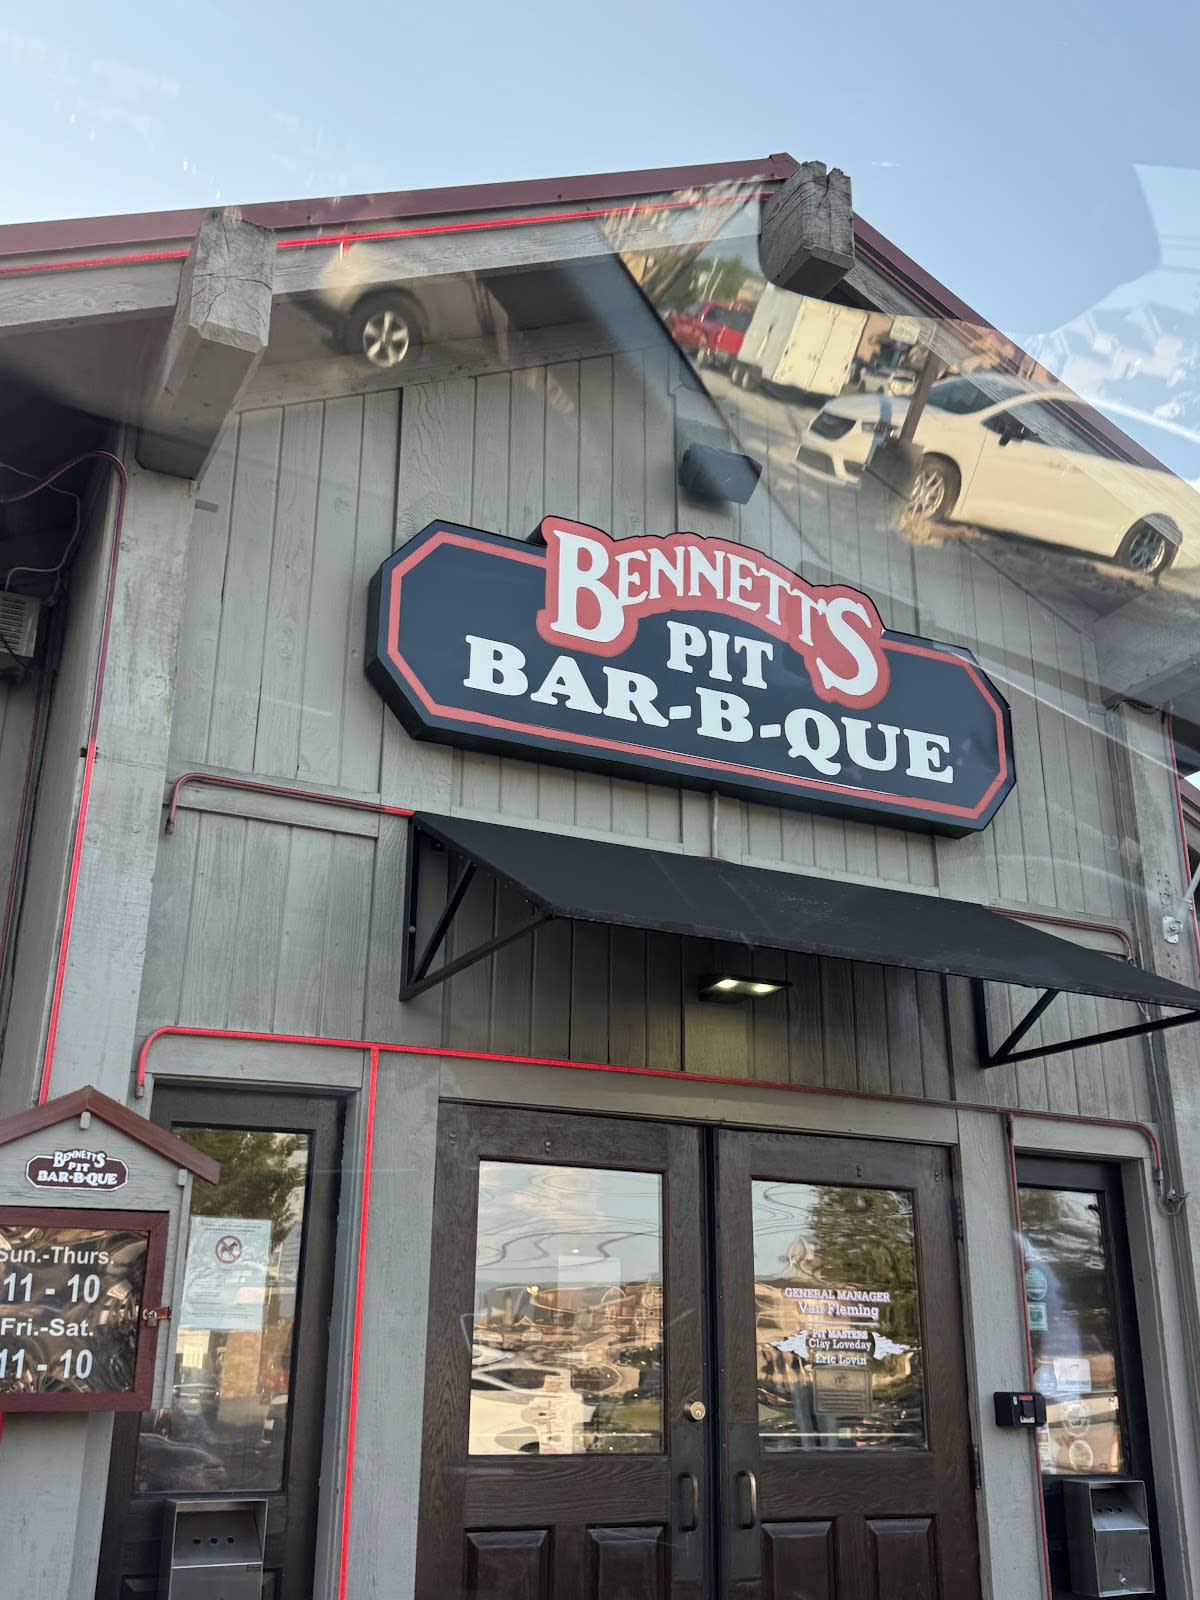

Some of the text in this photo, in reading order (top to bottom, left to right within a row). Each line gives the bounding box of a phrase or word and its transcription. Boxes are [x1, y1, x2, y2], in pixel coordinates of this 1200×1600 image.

[550, 529, 878, 696] BENNETT'S
[666, 620, 774, 690] PIT
[463, 634, 954, 784] BAR-B-QUE
[67, 1162, 91, 1172] PIT
[3, 1272, 33, 1302] 11
[67, 1274, 100, 1303] 10
[784, 1287, 891, 1302] GENERAL MANAGER
[800, 1302, 879, 1320] Van Fleming
[1, 1317, 94, 1336] Fri.-Sat.
[808, 1338, 872, 1352] Clay Loveday
[60, 1349, 93, 1379] 10
[815, 1354, 837, 1364] Eric
